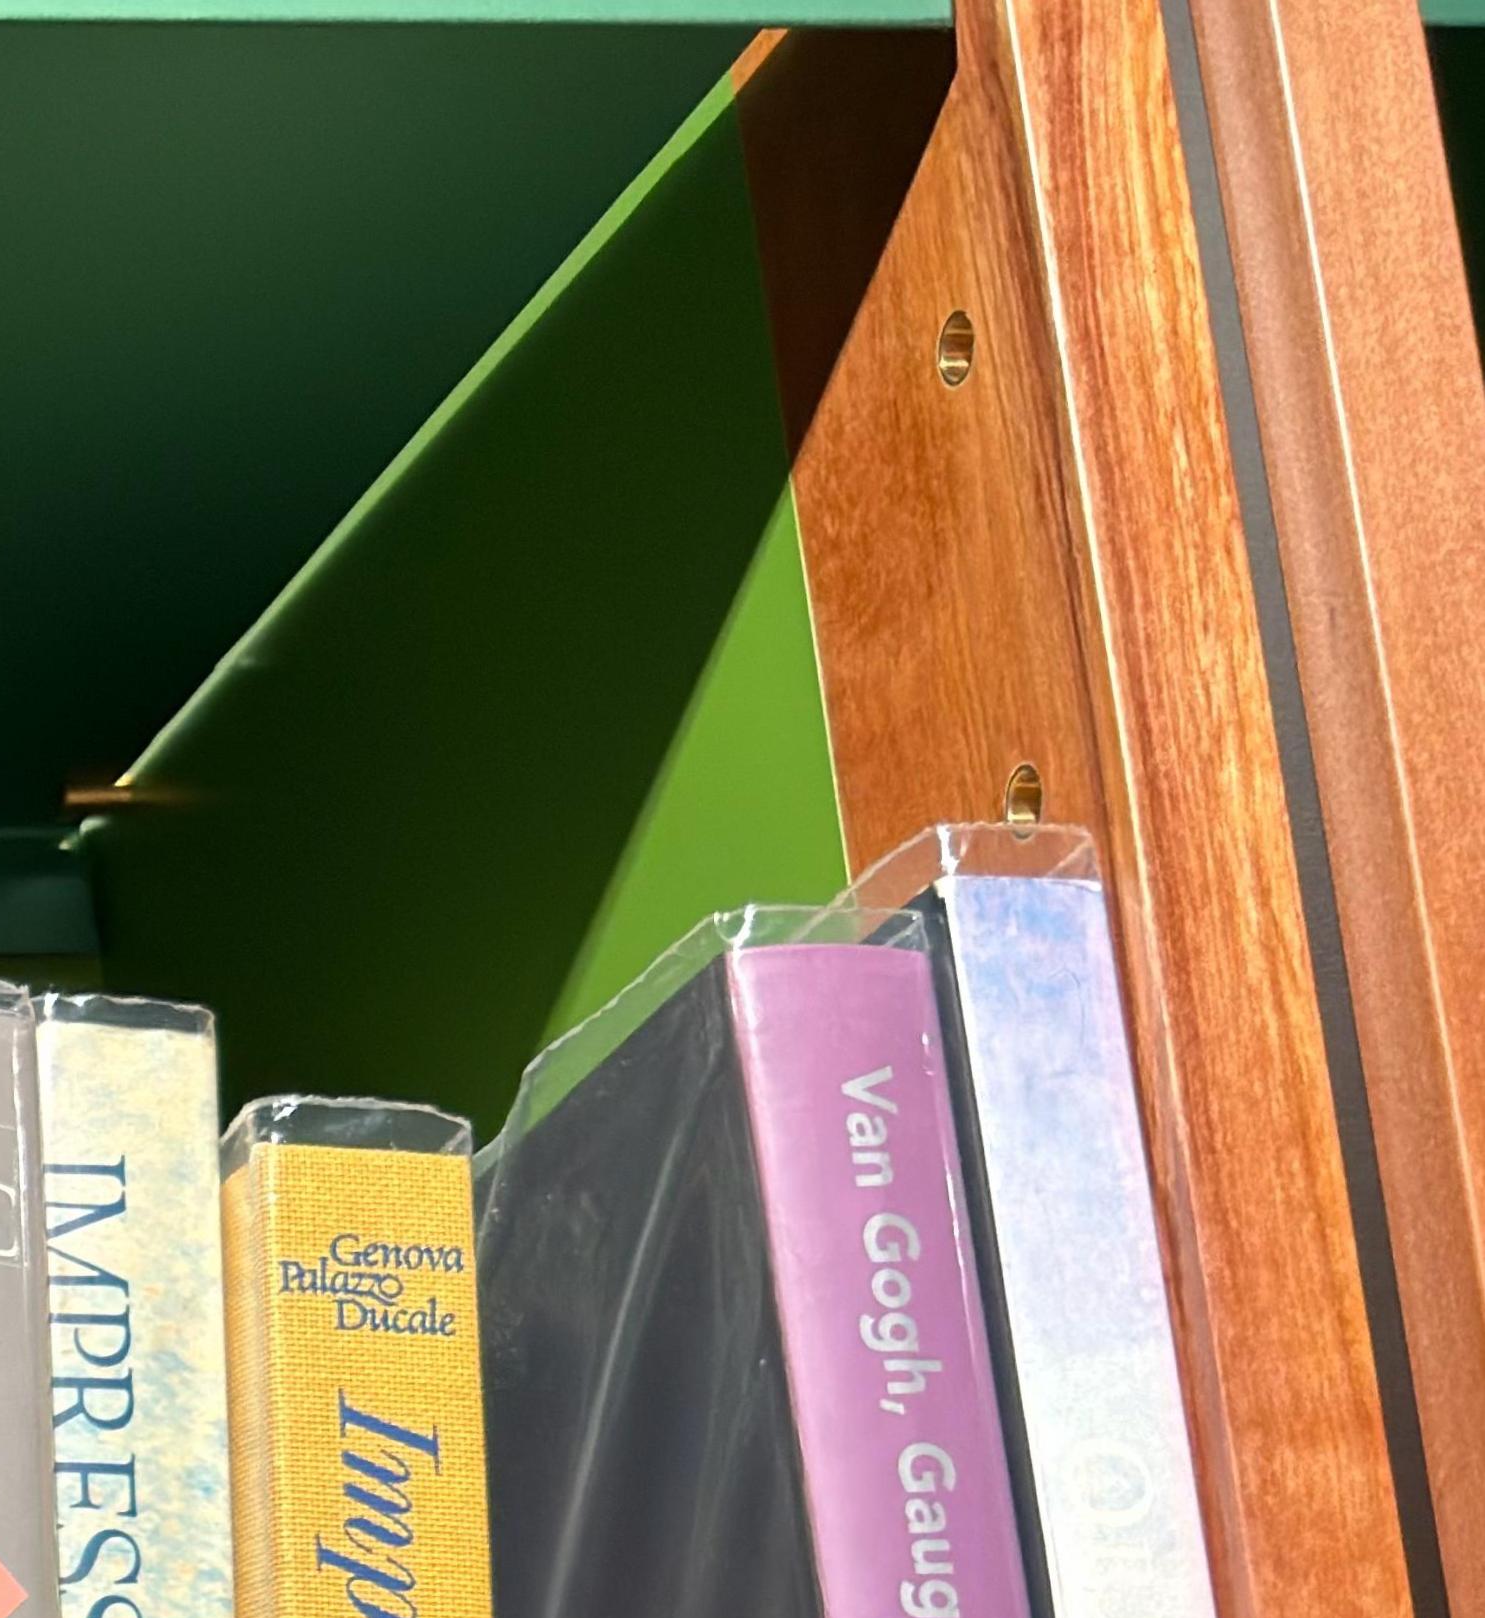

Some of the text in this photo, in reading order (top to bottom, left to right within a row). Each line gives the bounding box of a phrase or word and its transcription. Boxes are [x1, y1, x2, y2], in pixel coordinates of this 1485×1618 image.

[840, 1065, 897, 1188] Van
[329, 1233, 465, 1274] Genova
[279, 1260, 405, 1302] Palazzo
[335, 1299, 456, 1338] Ducale
[859, 1212, 944, 1416] Gogh,
